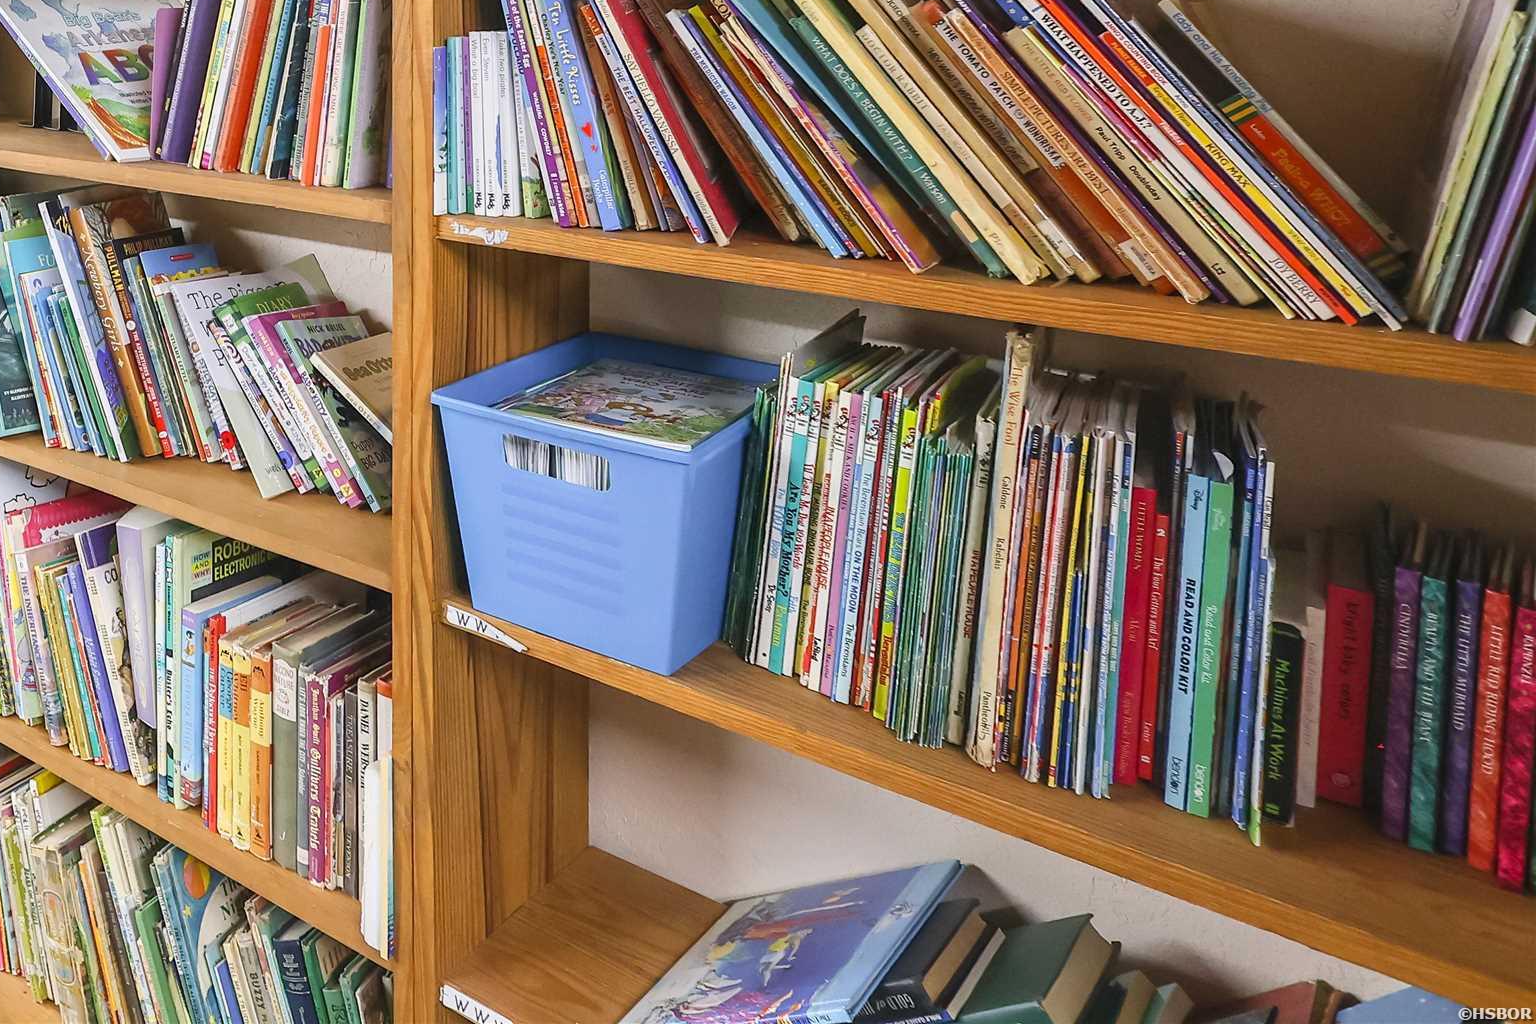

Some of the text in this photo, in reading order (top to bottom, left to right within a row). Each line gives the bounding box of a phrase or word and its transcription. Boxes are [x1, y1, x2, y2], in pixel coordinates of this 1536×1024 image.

[510, 6, 518, 14] of
[513, 17, 521, 27] the
[516, 29, 526, 51] Easter
[520, 53, 531, 68] Egg
[547, 1, 584, 105] Ten Little Kisses
[941, 24, 1061, 162] THE TOMATO PATCH WONDRISKA
[1040, 13, 1152, 130] WHAT HAPPENED TO A.J.?
[623, 52, 639, 72] SAY
[650, 106, 679, 153] VANESSA
[810, 36, 835, 64] WHAT
[832, 63, 857, 90] DOES
[859, 97, 886, 127] BEGIN
[882, 124, 914, 161] WITH?
[1000, 69, 1109, 196] SIMPLE PICTURES ARE BEST
[918, 171, 947, 206] Watson
[1094, 125, 1162, 202] Paul Tripp Doubleday
[1204, 140, 1249, 188] KING MAX
[104, 246, 125, 291] PULLMAN
[1268, 253, 1322, 307] JOY BERRY
[83, 246, 121, 352] Newbery Girls
[188, 290, 222, 310] The
[1002, 366, 1024, 447] The Wise Fool
[999, 475, 1012, 509] Galdone
[193, 550, 210, 562] HOW
[775, 481, 799, 597] Are You My Mother?
[992, 537, 1006, 569] Rabelais
[194, 560, 210, 570] AND
[847, 550, 860, 612] ON THE MOON
[1176, 578, 1197, 694] READ AND COLOR KIT
[1394, 602, 1411, 671] CINDERELLA
[1518, 634, 1535, 683] RAPUNZEL
[1452, 613, 1472, 731] THE LITTLE MERMAID
[1266, 659, 1291, 779] Machines At Work
[1479, 625, 1503, 774] LITTLE RED RIDING HOOD
[1167, 757, 1184, 793] bendon
[309, 805, 323, 849] Travels
[248, 970, 266, 1009] BUZZY
[888, 992, 914, 1010] GOLD
